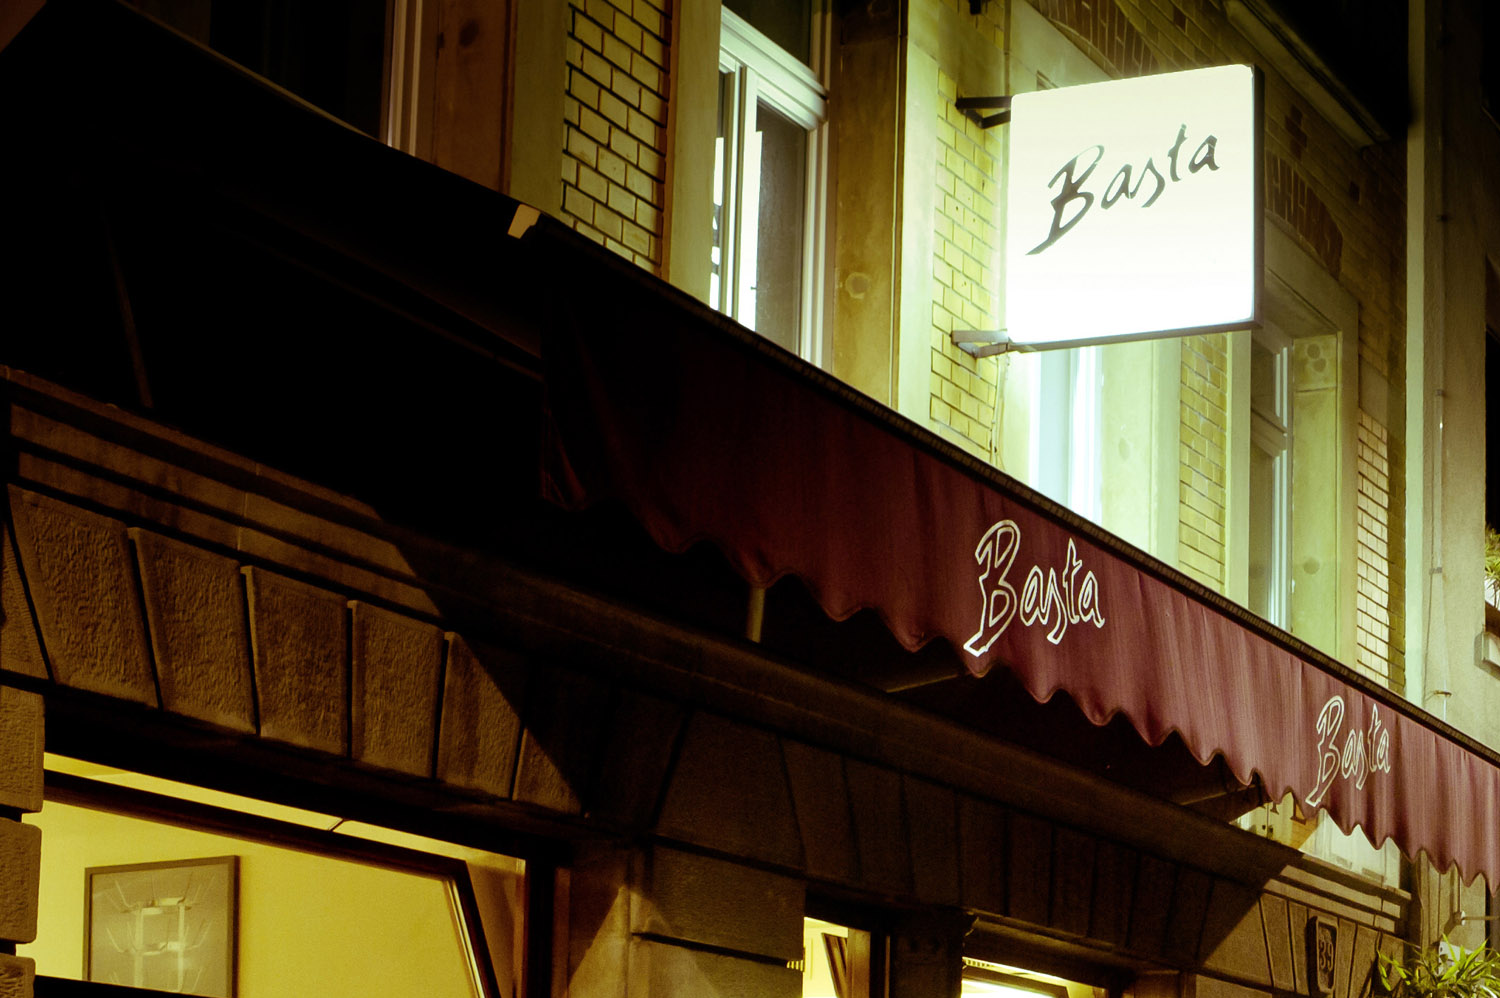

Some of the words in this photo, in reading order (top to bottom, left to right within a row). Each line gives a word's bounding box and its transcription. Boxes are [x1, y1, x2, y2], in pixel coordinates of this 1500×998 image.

[1026, 123, 1221, 256] Basta
[963, 518, 1106, 657] Basta
[1305, 694, 1392, 808] Basta
